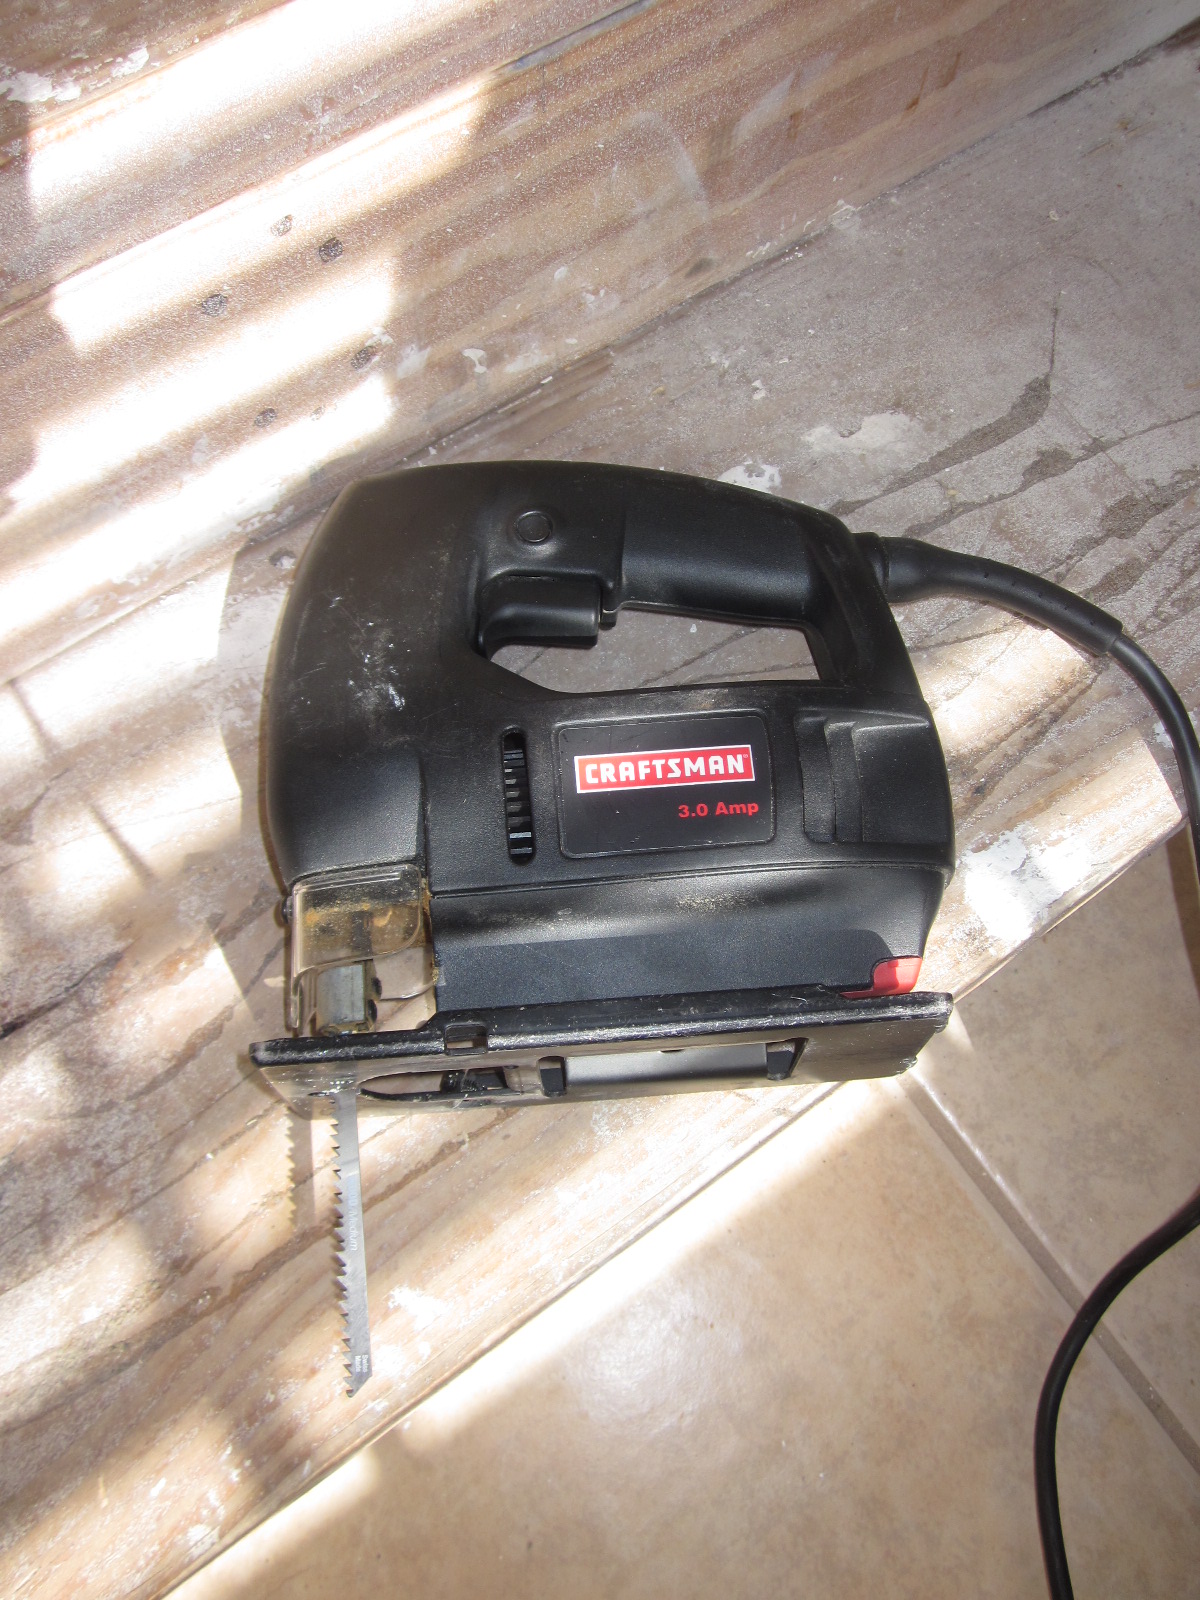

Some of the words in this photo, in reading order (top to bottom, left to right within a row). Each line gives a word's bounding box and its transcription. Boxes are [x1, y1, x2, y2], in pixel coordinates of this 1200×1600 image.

[584, 753, 745, 784] CRAFTSMAN
[678, 803, 709, 818] 3.0
[715, 801, 759, 817] Amp
[348, 1210, 359, 1251] Medium
